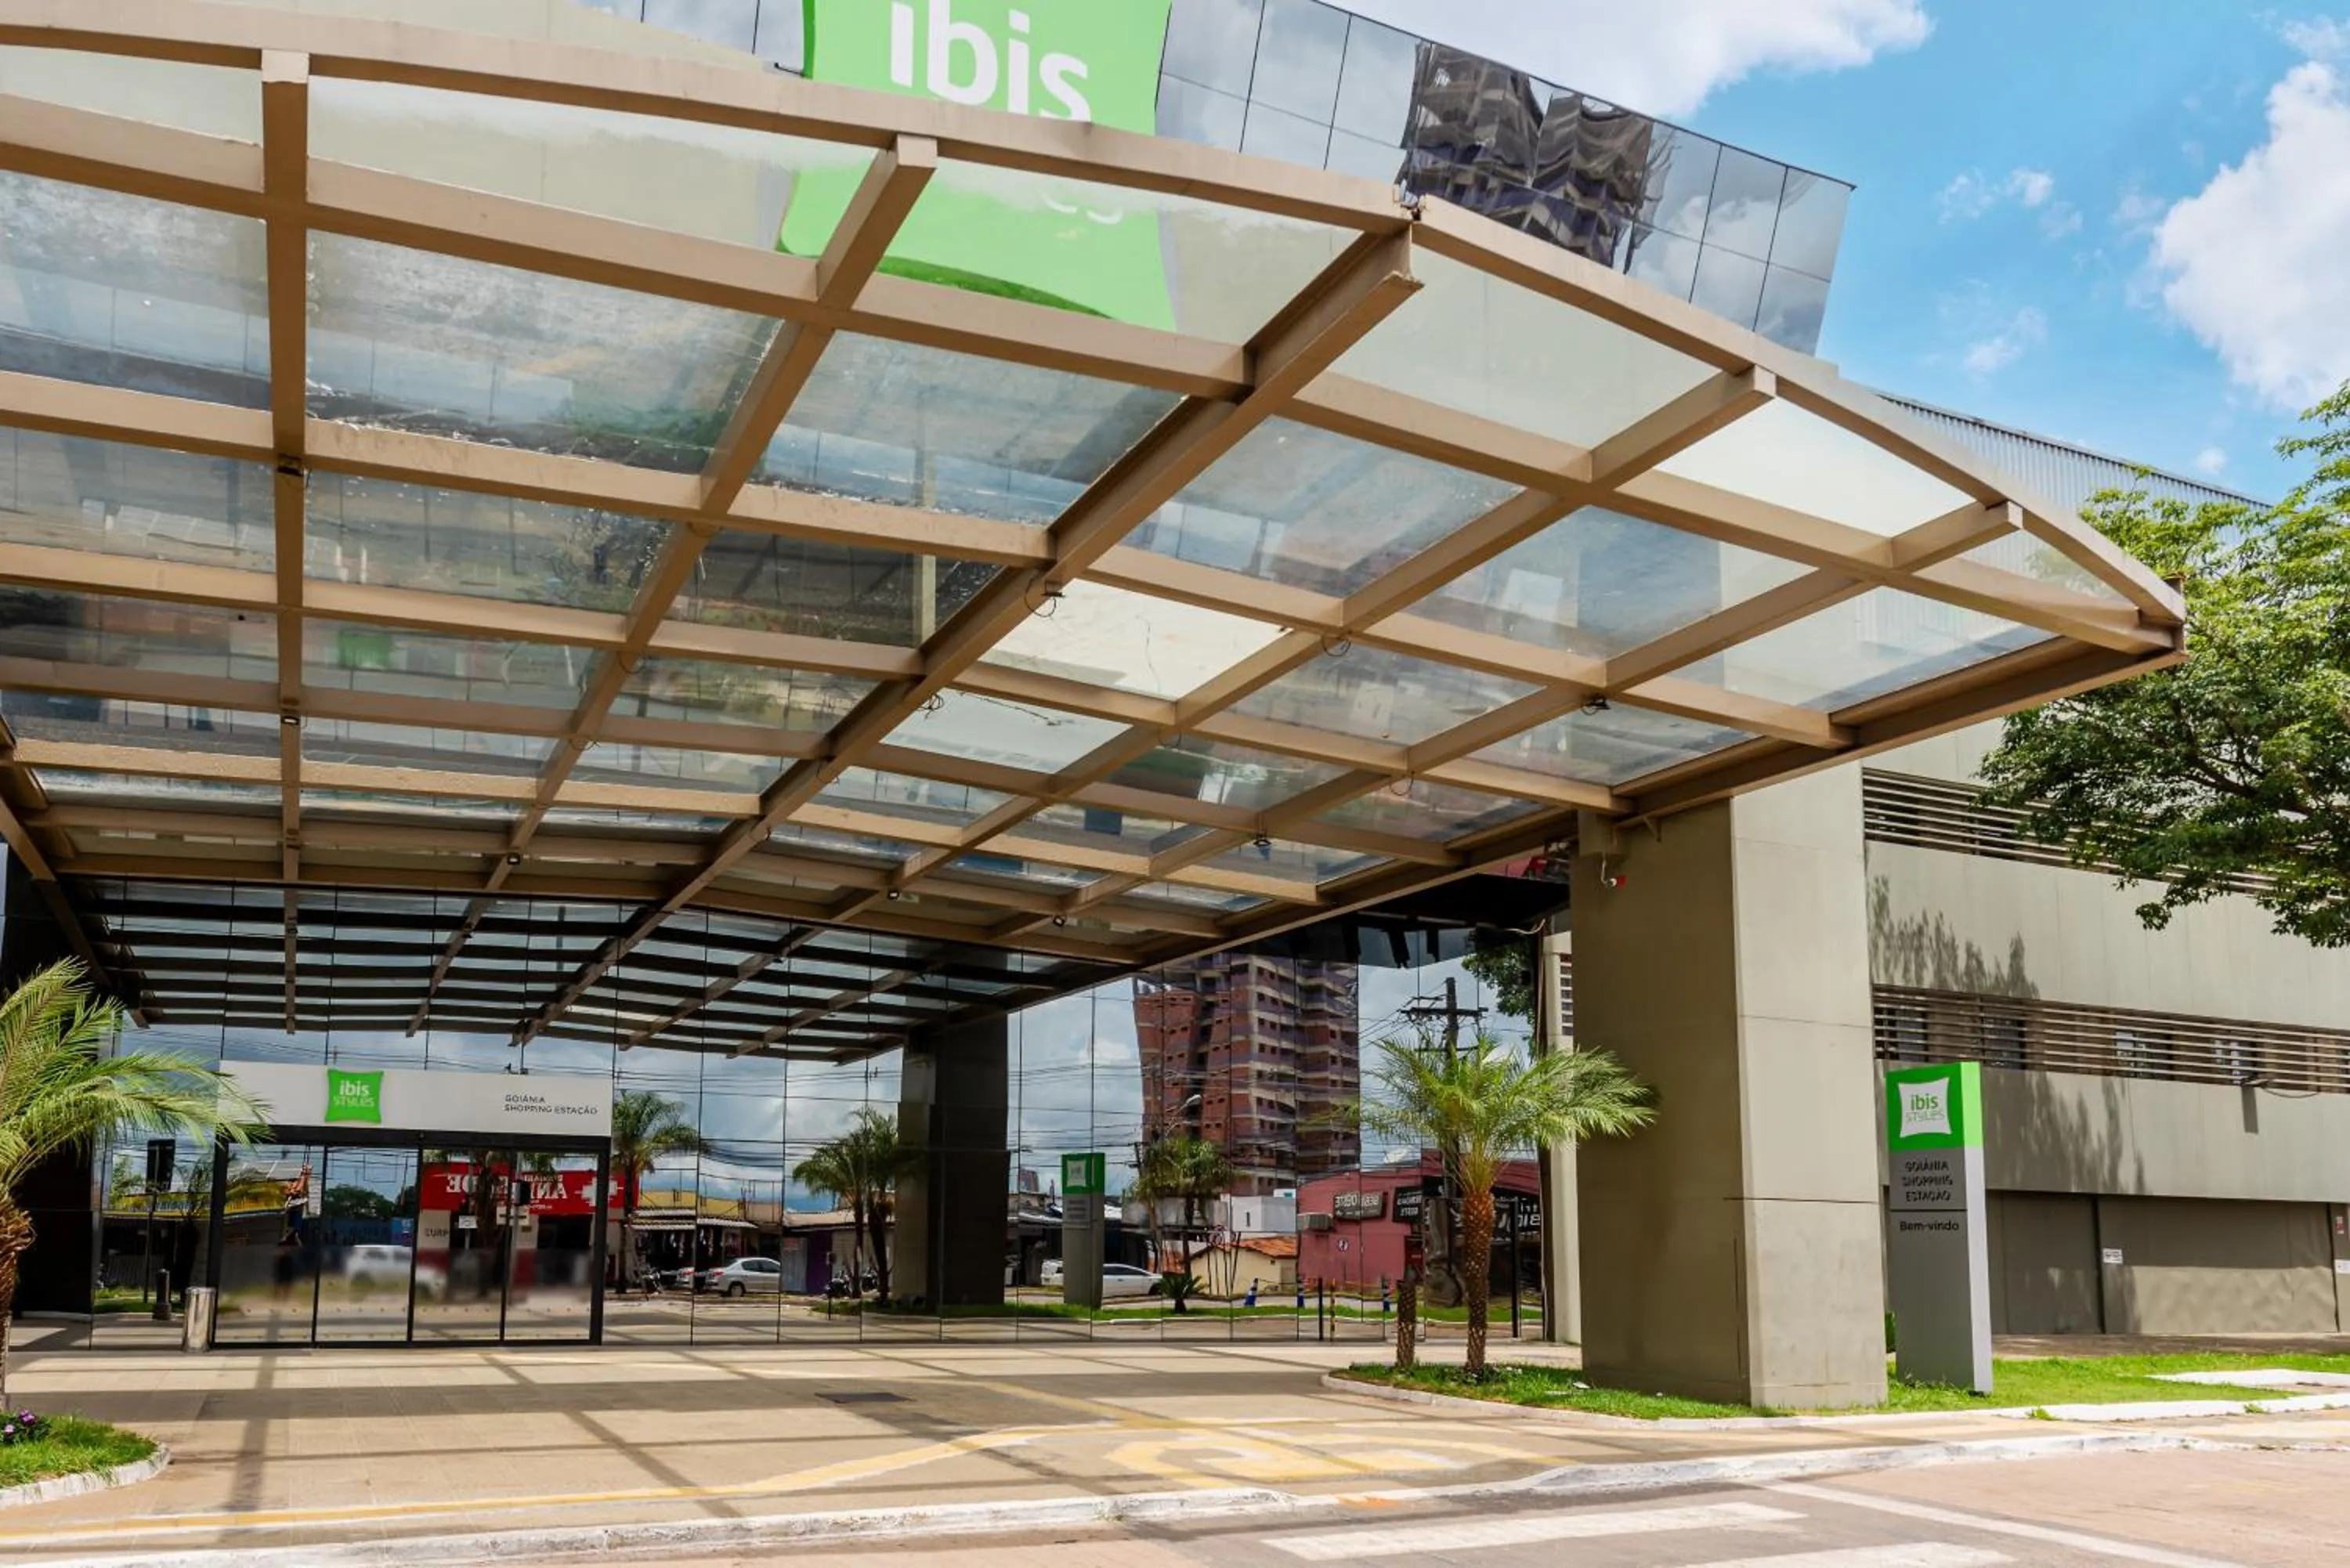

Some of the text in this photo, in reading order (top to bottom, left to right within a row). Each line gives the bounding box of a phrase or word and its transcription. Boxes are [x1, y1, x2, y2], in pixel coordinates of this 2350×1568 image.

[891, 0, 1091, 121] ibis
[340, 1080, 371, 1097] ibis
[1911, 1093, 1939, 1111] ibis
[504, 1104, 552, 1113] SHOPPING
[1905, 1111, 1946, 1122] STYLES
[1902, 1175, 1954, 1187] SHOPPING
[1900, 1221, 1959, 1232] Bem-vindo
